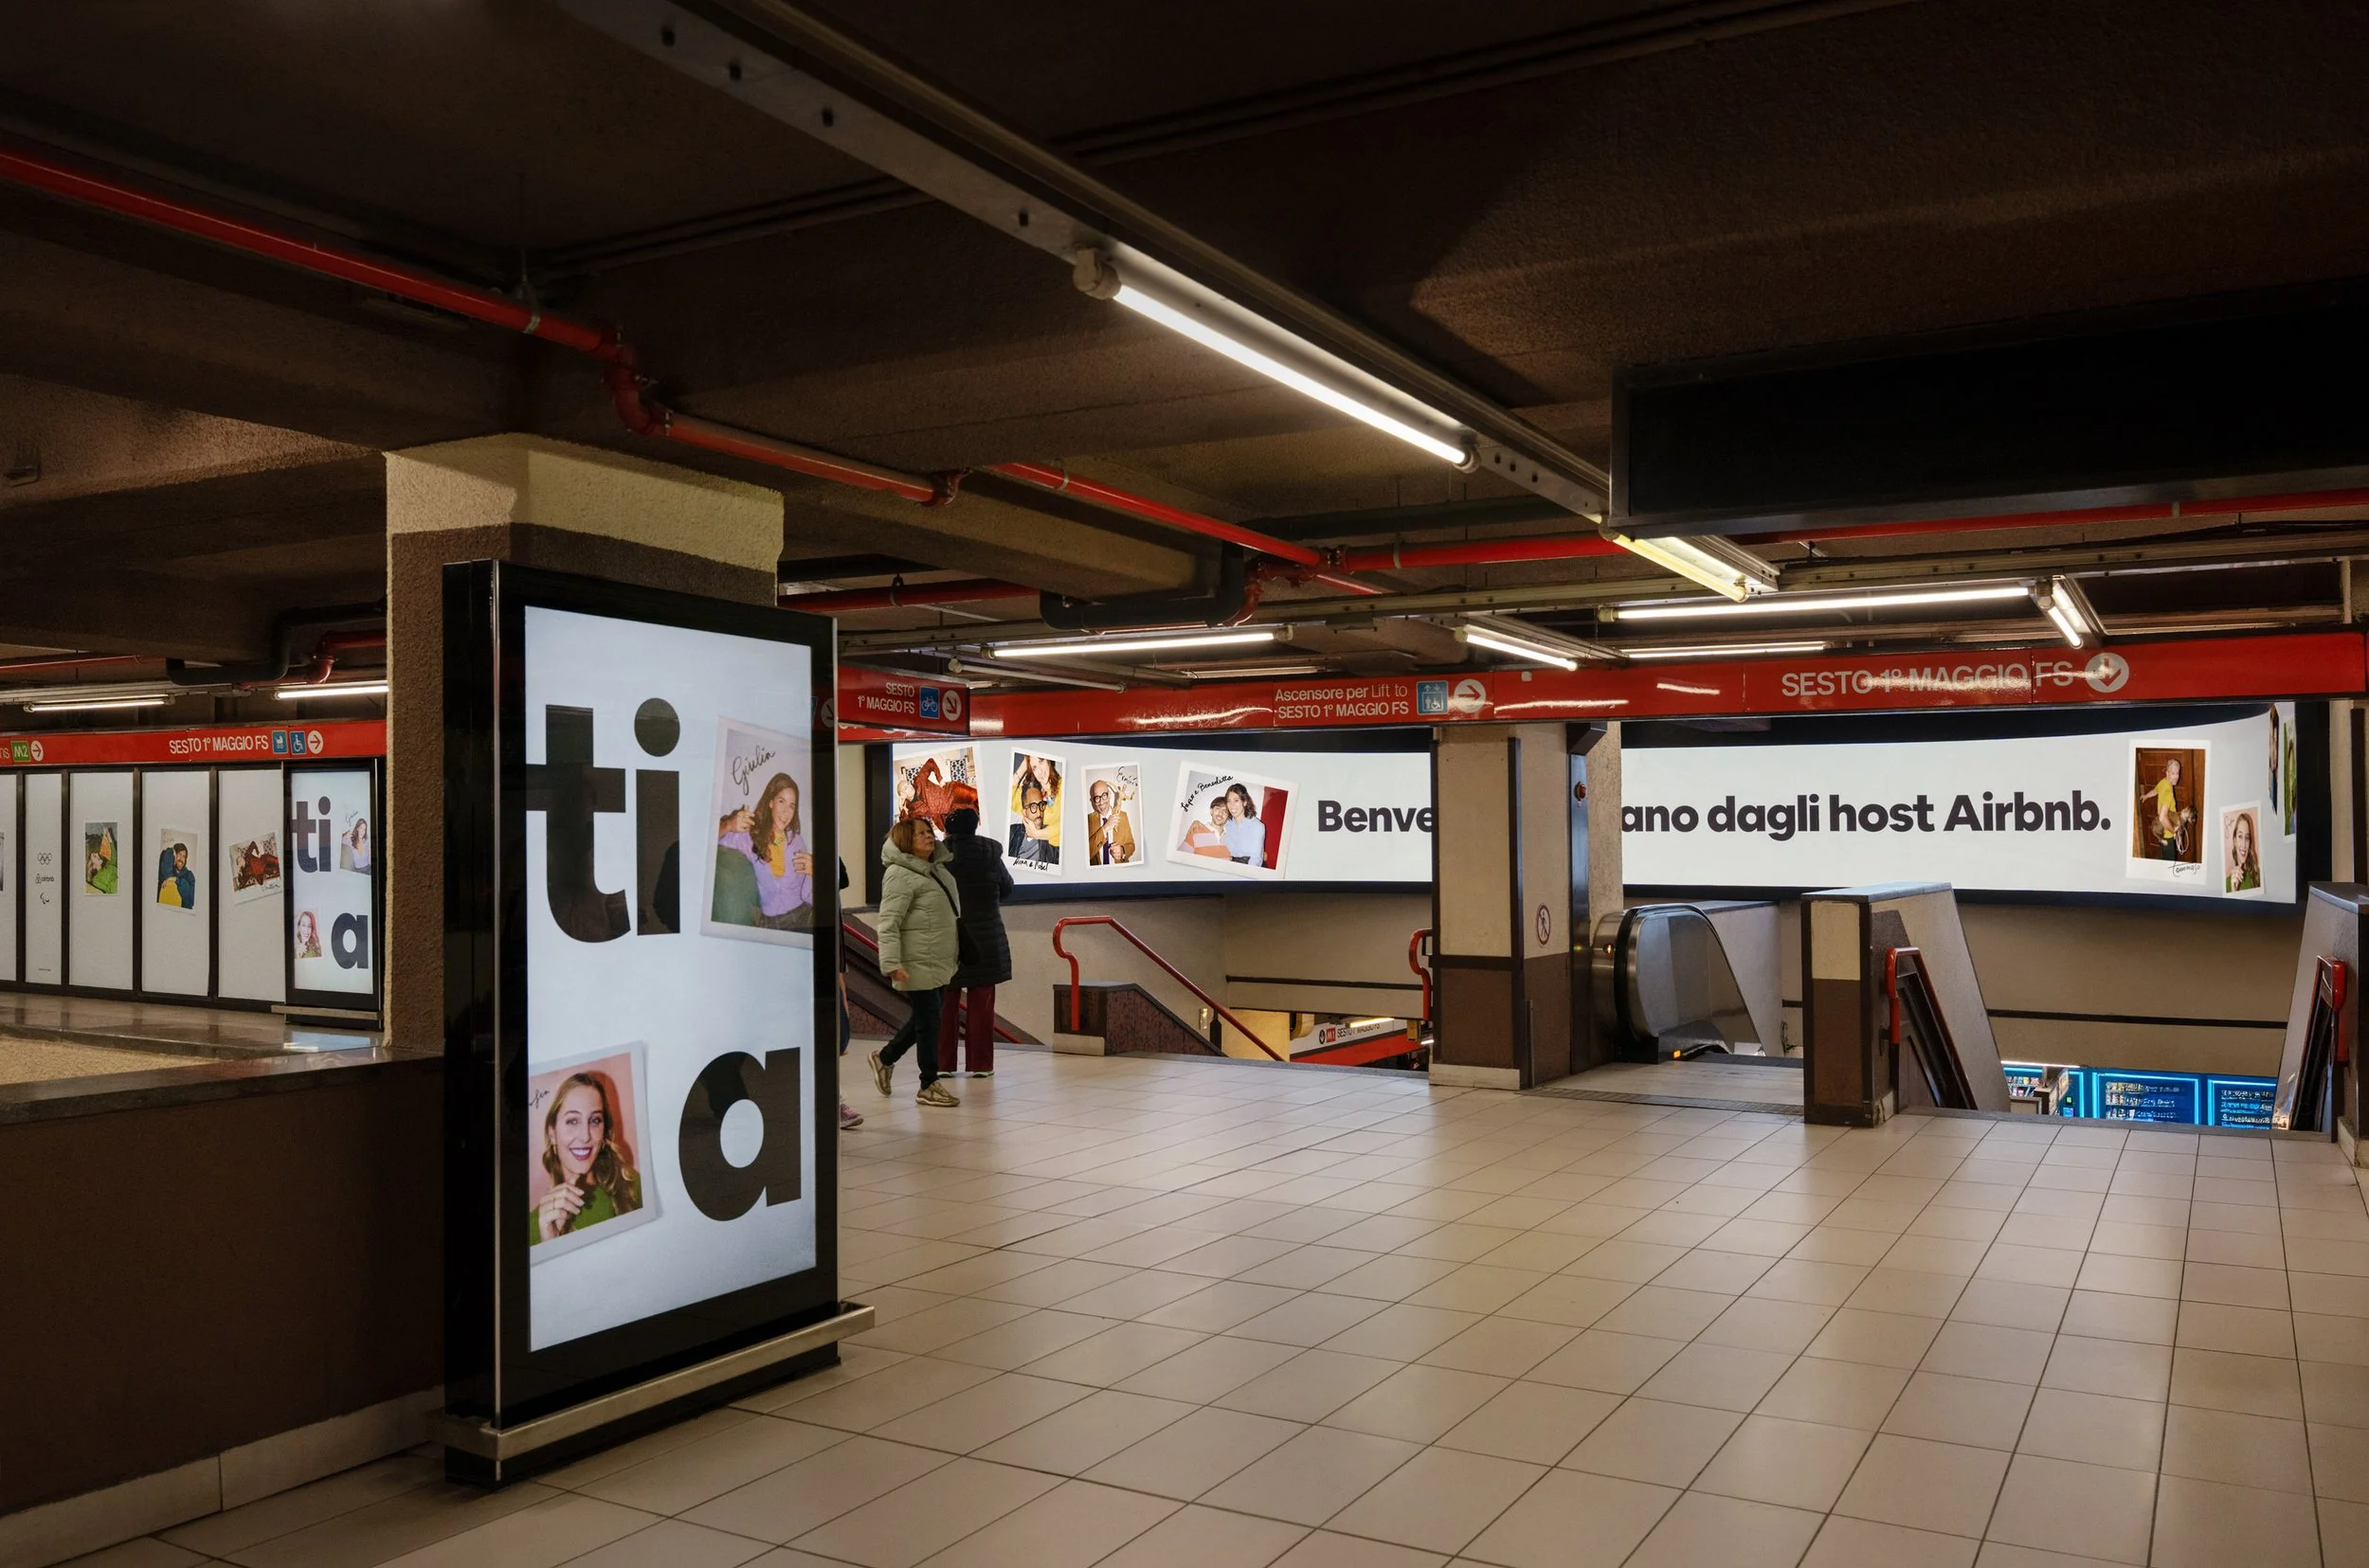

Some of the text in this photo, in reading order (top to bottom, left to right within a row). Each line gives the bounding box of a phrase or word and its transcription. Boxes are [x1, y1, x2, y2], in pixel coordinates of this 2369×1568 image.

[885, 682, 915, 697] SESTO
[1275, 683, 1408, 701] Ascensore per Lift to
[1781, 670, 1873, 696] SESTO
[1908, 662, 2028, 693] MAGGIO
[2034, 660, 2073, 686] FS
[866, 696, 902, 712] MAGGIO
[903, 701, 915, 713] FS
[1278, 705, 1321, 719] SESTO
[1336, 702, 1389, 716] MAGGIO
[1392, 701, 1409, 715] FS
[14, 746, 28, 758] M2
[169, 737, 202, 754] SESTO
[212, 735, 254, 751] MAGGIO
[255, 735, 269, 750] FS
[732, 745, 776, 796] Giulia
[526, 697, 681, 943] ti
[1708, 792, 1819, 841] dagli
[1829, 793, 1935, 832] host
[1944, 789, 2112, 832] Airbnb.
[291, 796, 332, 873] ti
[331, 912, 369, 969] a
[678, 1047, 802, 1222] a
